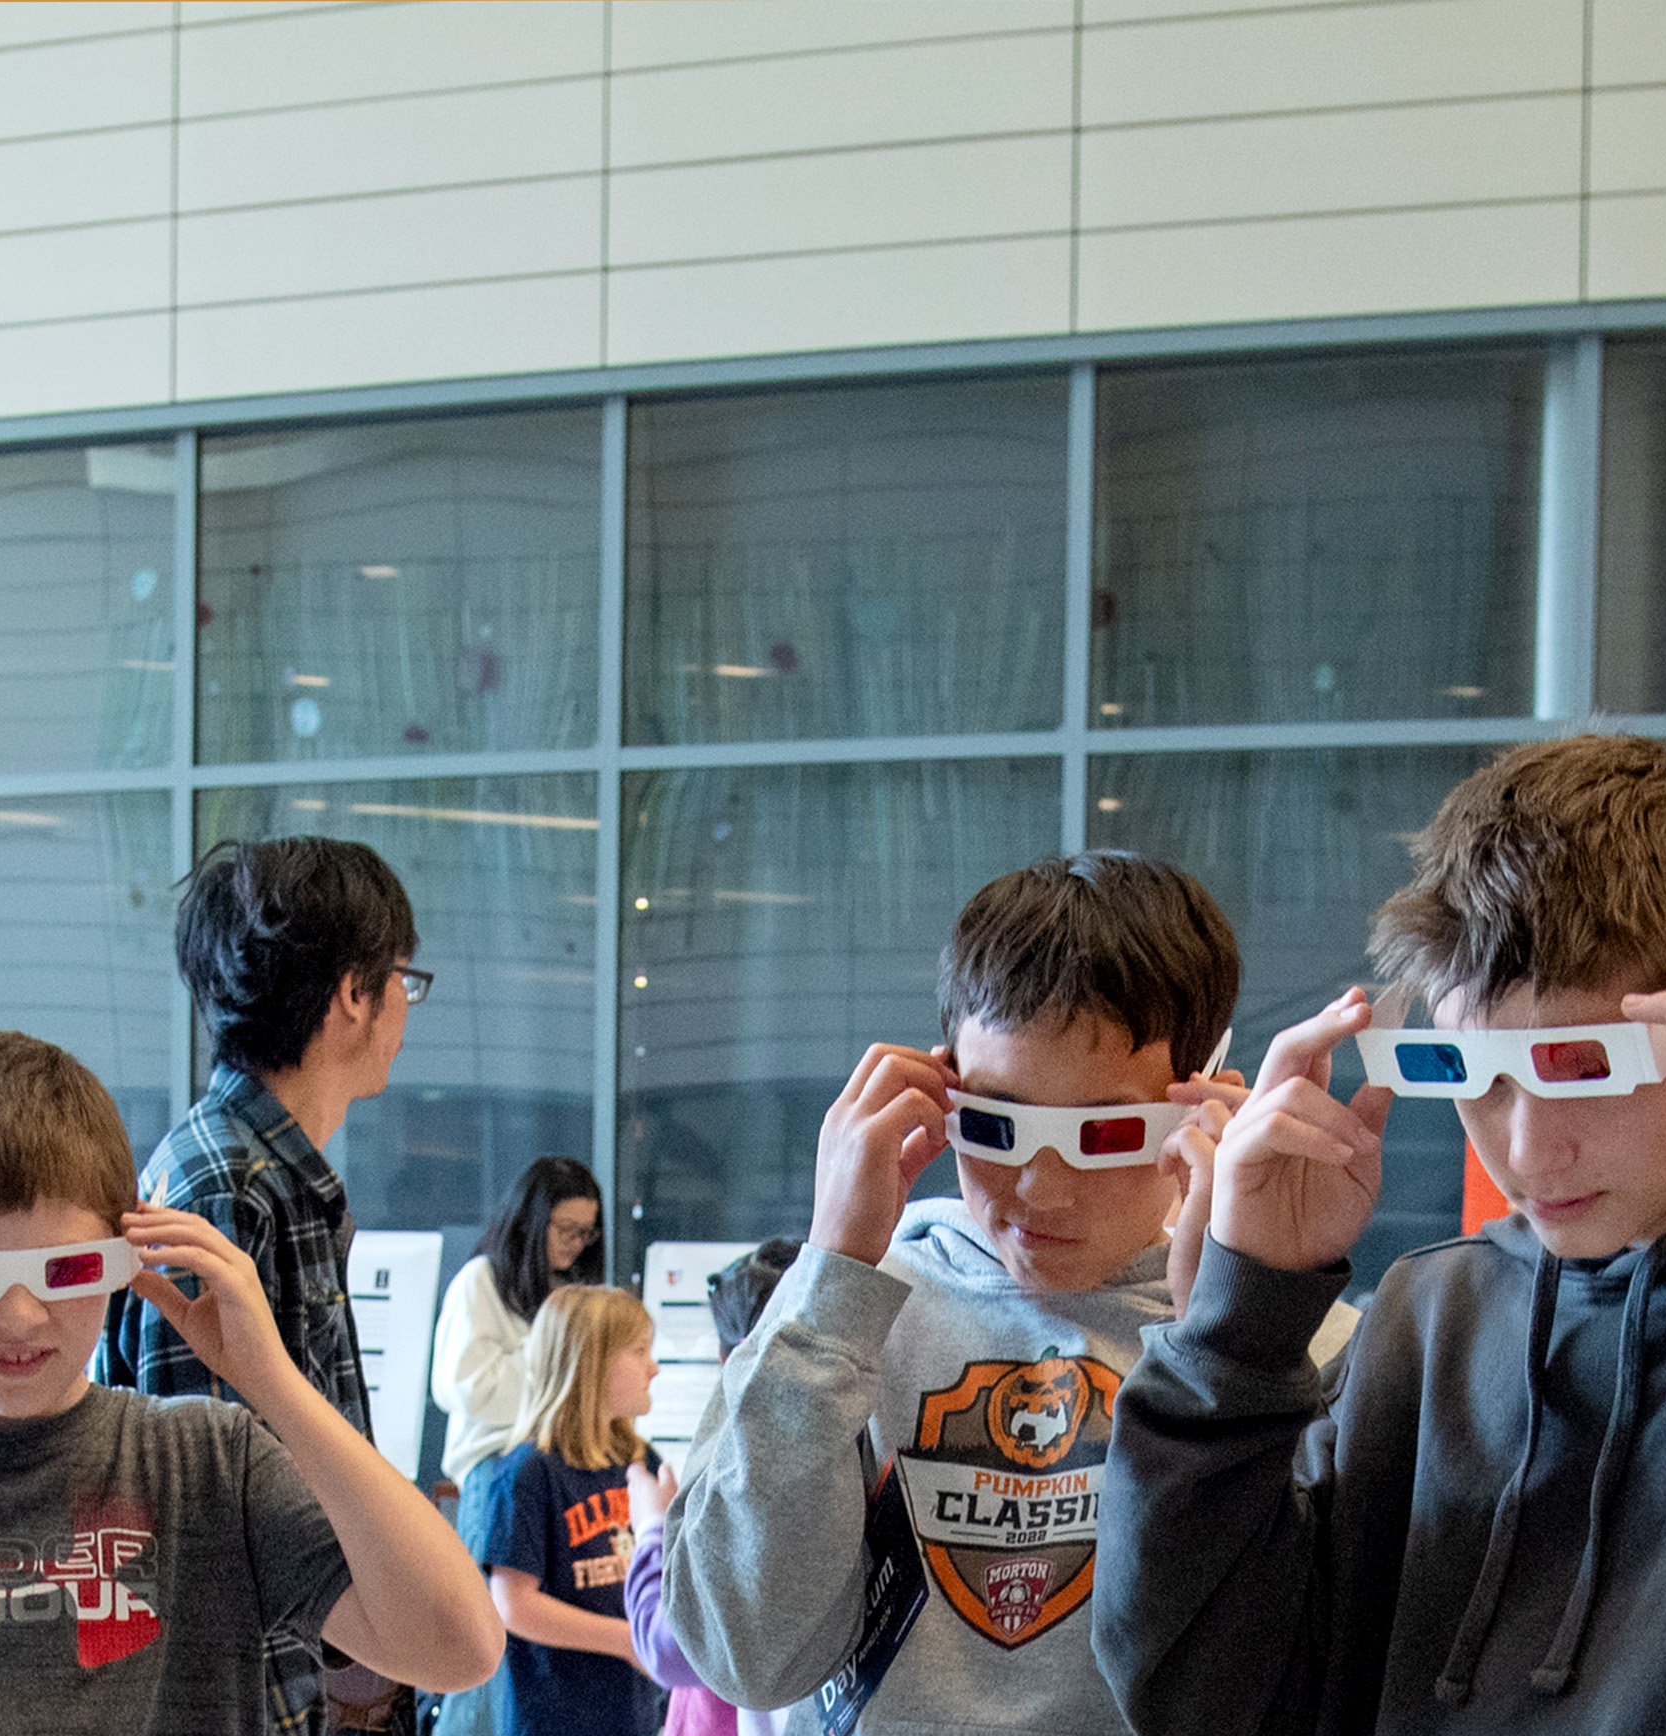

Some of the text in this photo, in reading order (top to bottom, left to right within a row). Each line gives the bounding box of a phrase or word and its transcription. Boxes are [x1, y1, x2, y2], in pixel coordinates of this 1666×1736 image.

[974, 1471, 1088, 1499] PUMPKIN
[935, 1490, 1100, 1530] CLASSI
[1005, 1530, 1047, 1545] 2022
[988, 1561, 1049, 1584] MORTON
[819, 1653, 858, 1713] Day
